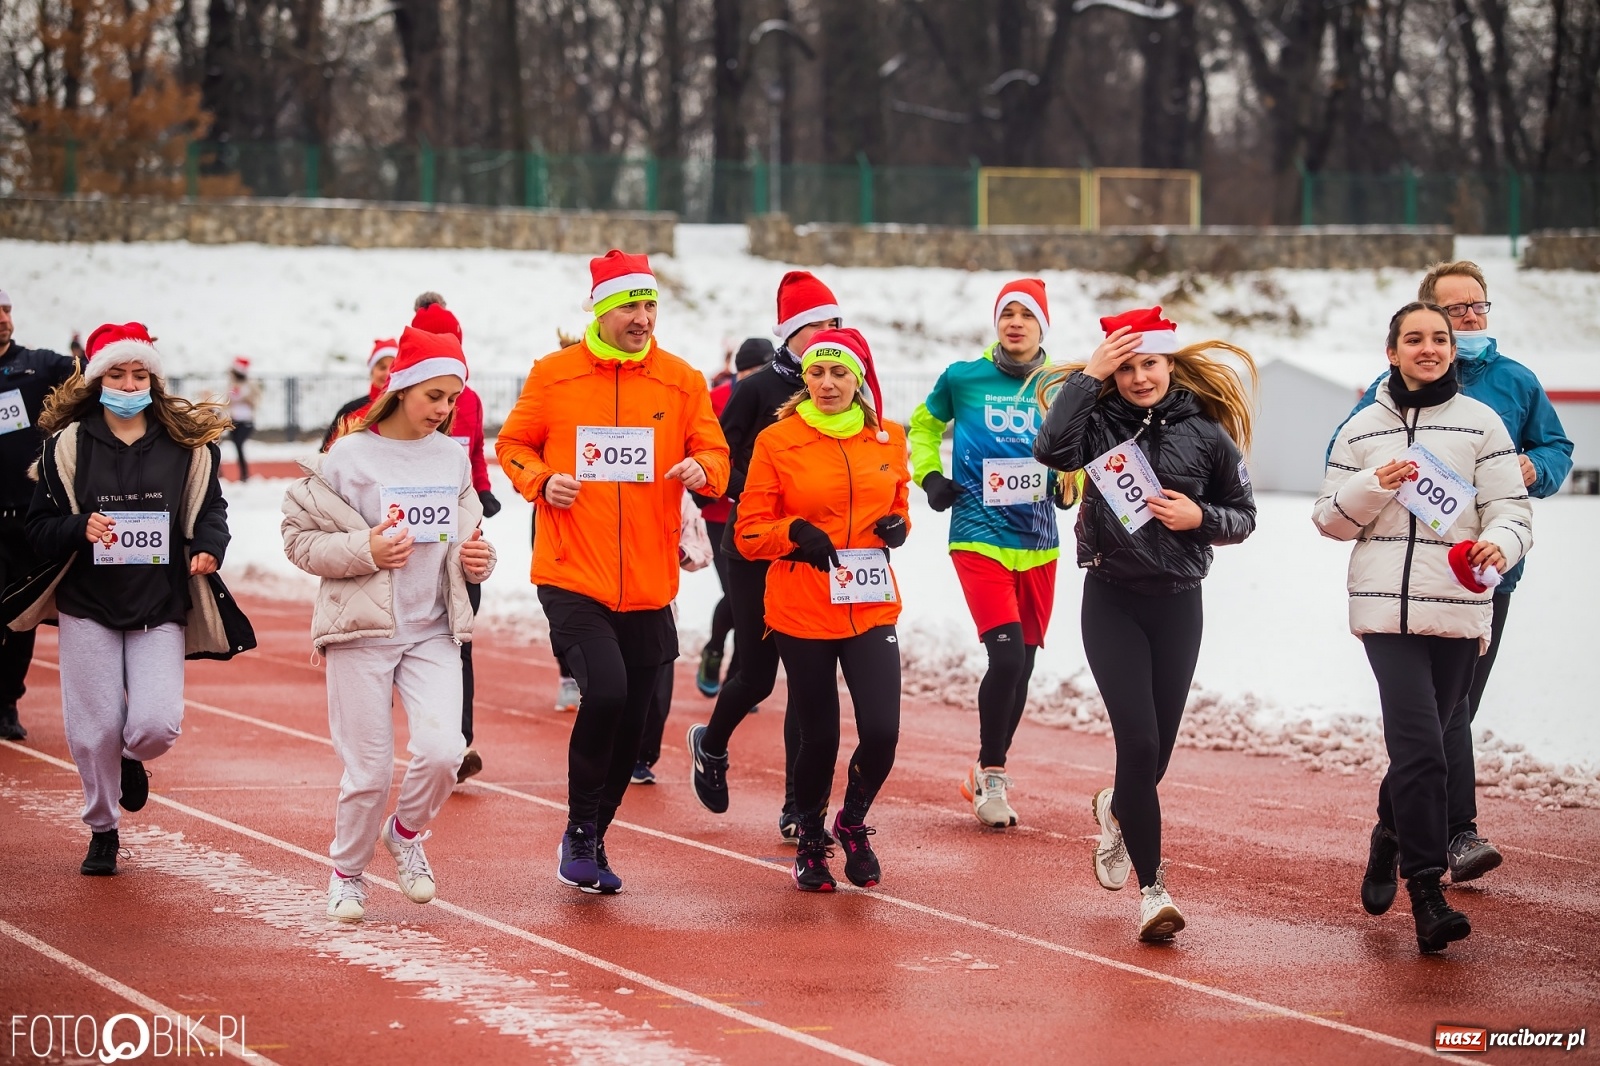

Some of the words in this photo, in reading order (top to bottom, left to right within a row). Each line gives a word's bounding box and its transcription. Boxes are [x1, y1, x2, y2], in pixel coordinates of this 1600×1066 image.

[817, 349, 841, 357] HERO
[985, 394, 1038, 404] BiegamBoLub
[995, 436, 1029, 444] RACIBORZ
[604, 446, 647, 465] 052
[1007, 473, 1041, 490] 083
[1116, 472, 1148, 514] 091
[1416, 477, 1458, 515] 090
[407, 506, 451, 525] 092
[121, 531, 163, 548] 088
[855, 568, 887, 586] 051
